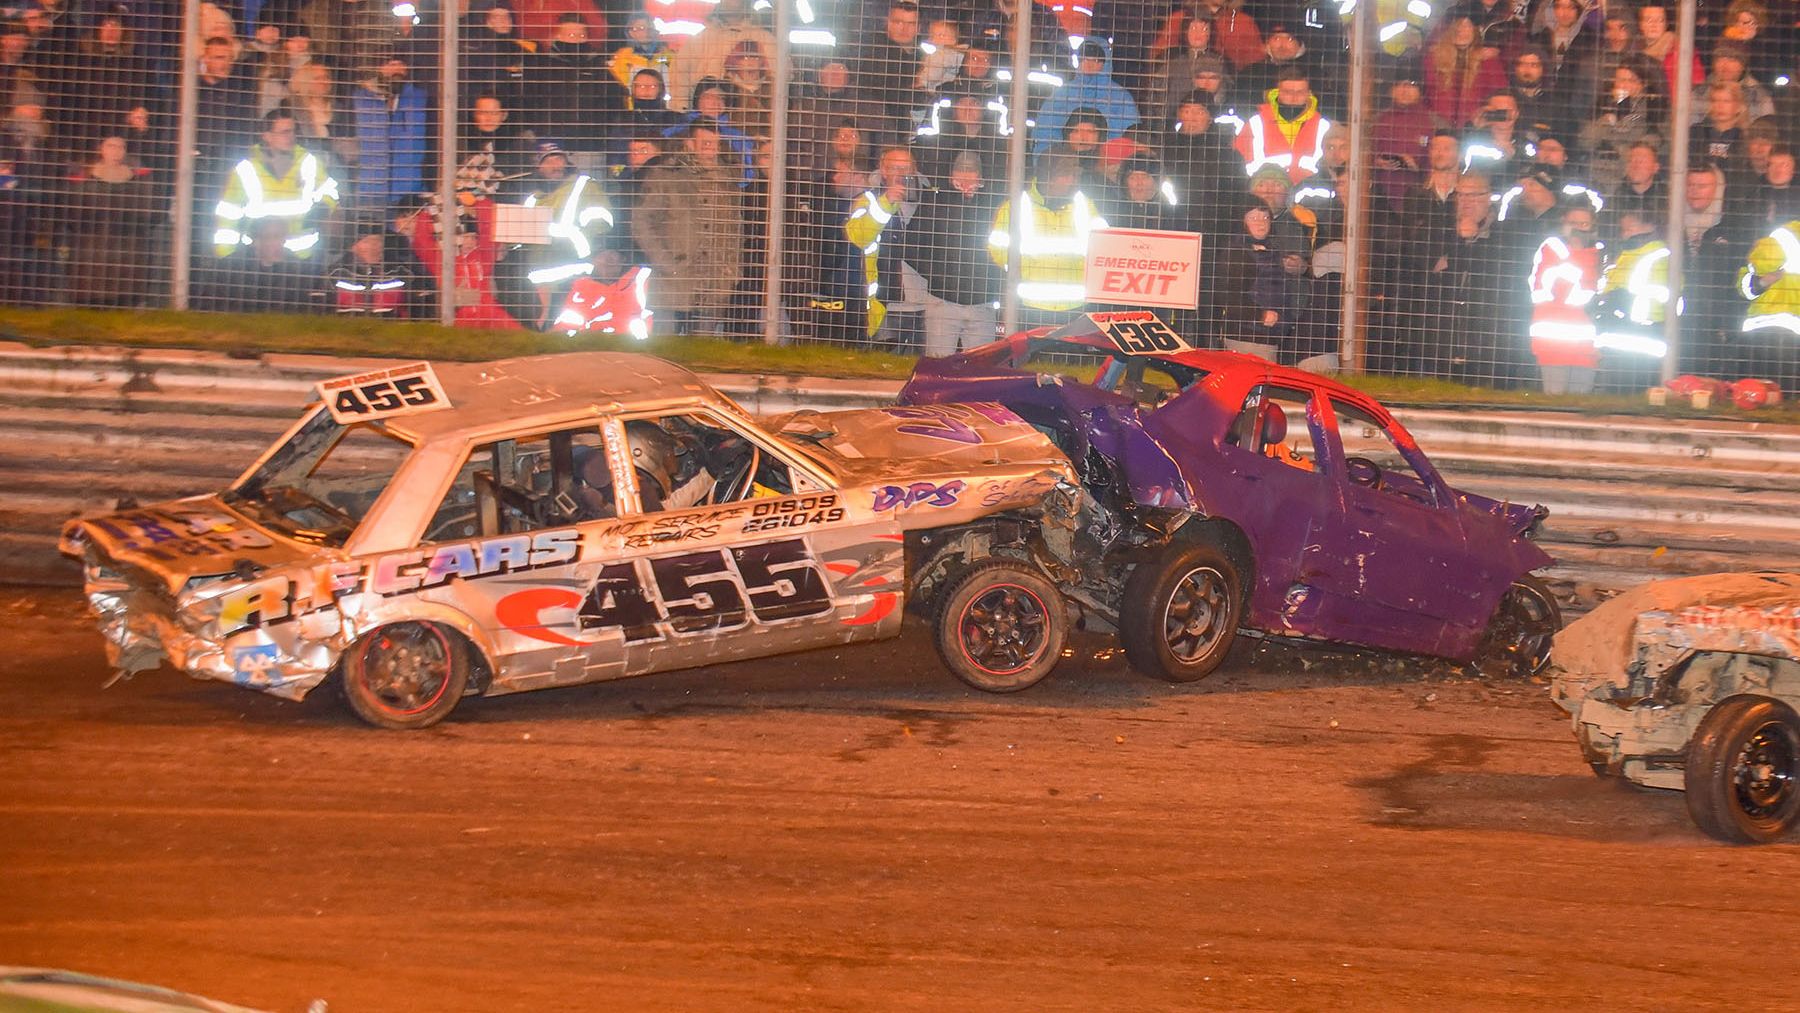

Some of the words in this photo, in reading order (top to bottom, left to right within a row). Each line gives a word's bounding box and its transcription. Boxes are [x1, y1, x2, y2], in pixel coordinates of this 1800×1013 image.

[1094, 256, 1190, 273] EMERGENCY
[1102, 271, 1178, 296] EXIT
[1106, 322, 1181, 352] 136
[336, 376, 439, 414] 455
[600, 520, 648, 538] MOT
[653, 507, 748, 530] SERVICE
[372, 529, 585, 597] CARS
[576, 536, 835, 646] 455
